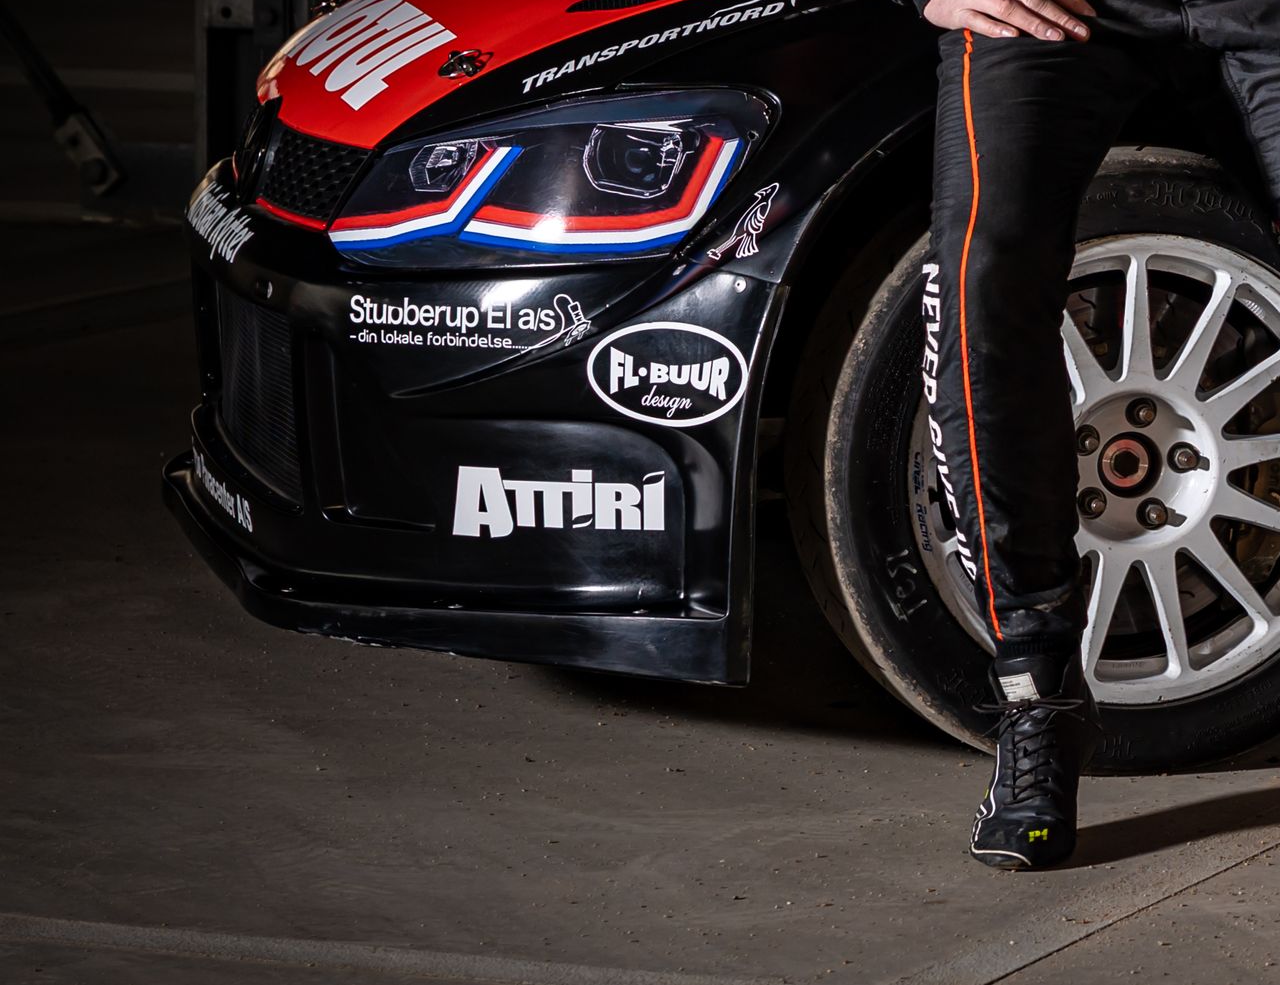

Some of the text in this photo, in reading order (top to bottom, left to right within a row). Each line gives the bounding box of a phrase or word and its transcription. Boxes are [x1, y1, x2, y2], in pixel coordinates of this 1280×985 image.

[522, 0, 784, 95] TRANSPORTNORD
[517, 307, 556, 331] a/s
[380, 331, 424, 345] lokale
[640, 387, 692, 418] design
